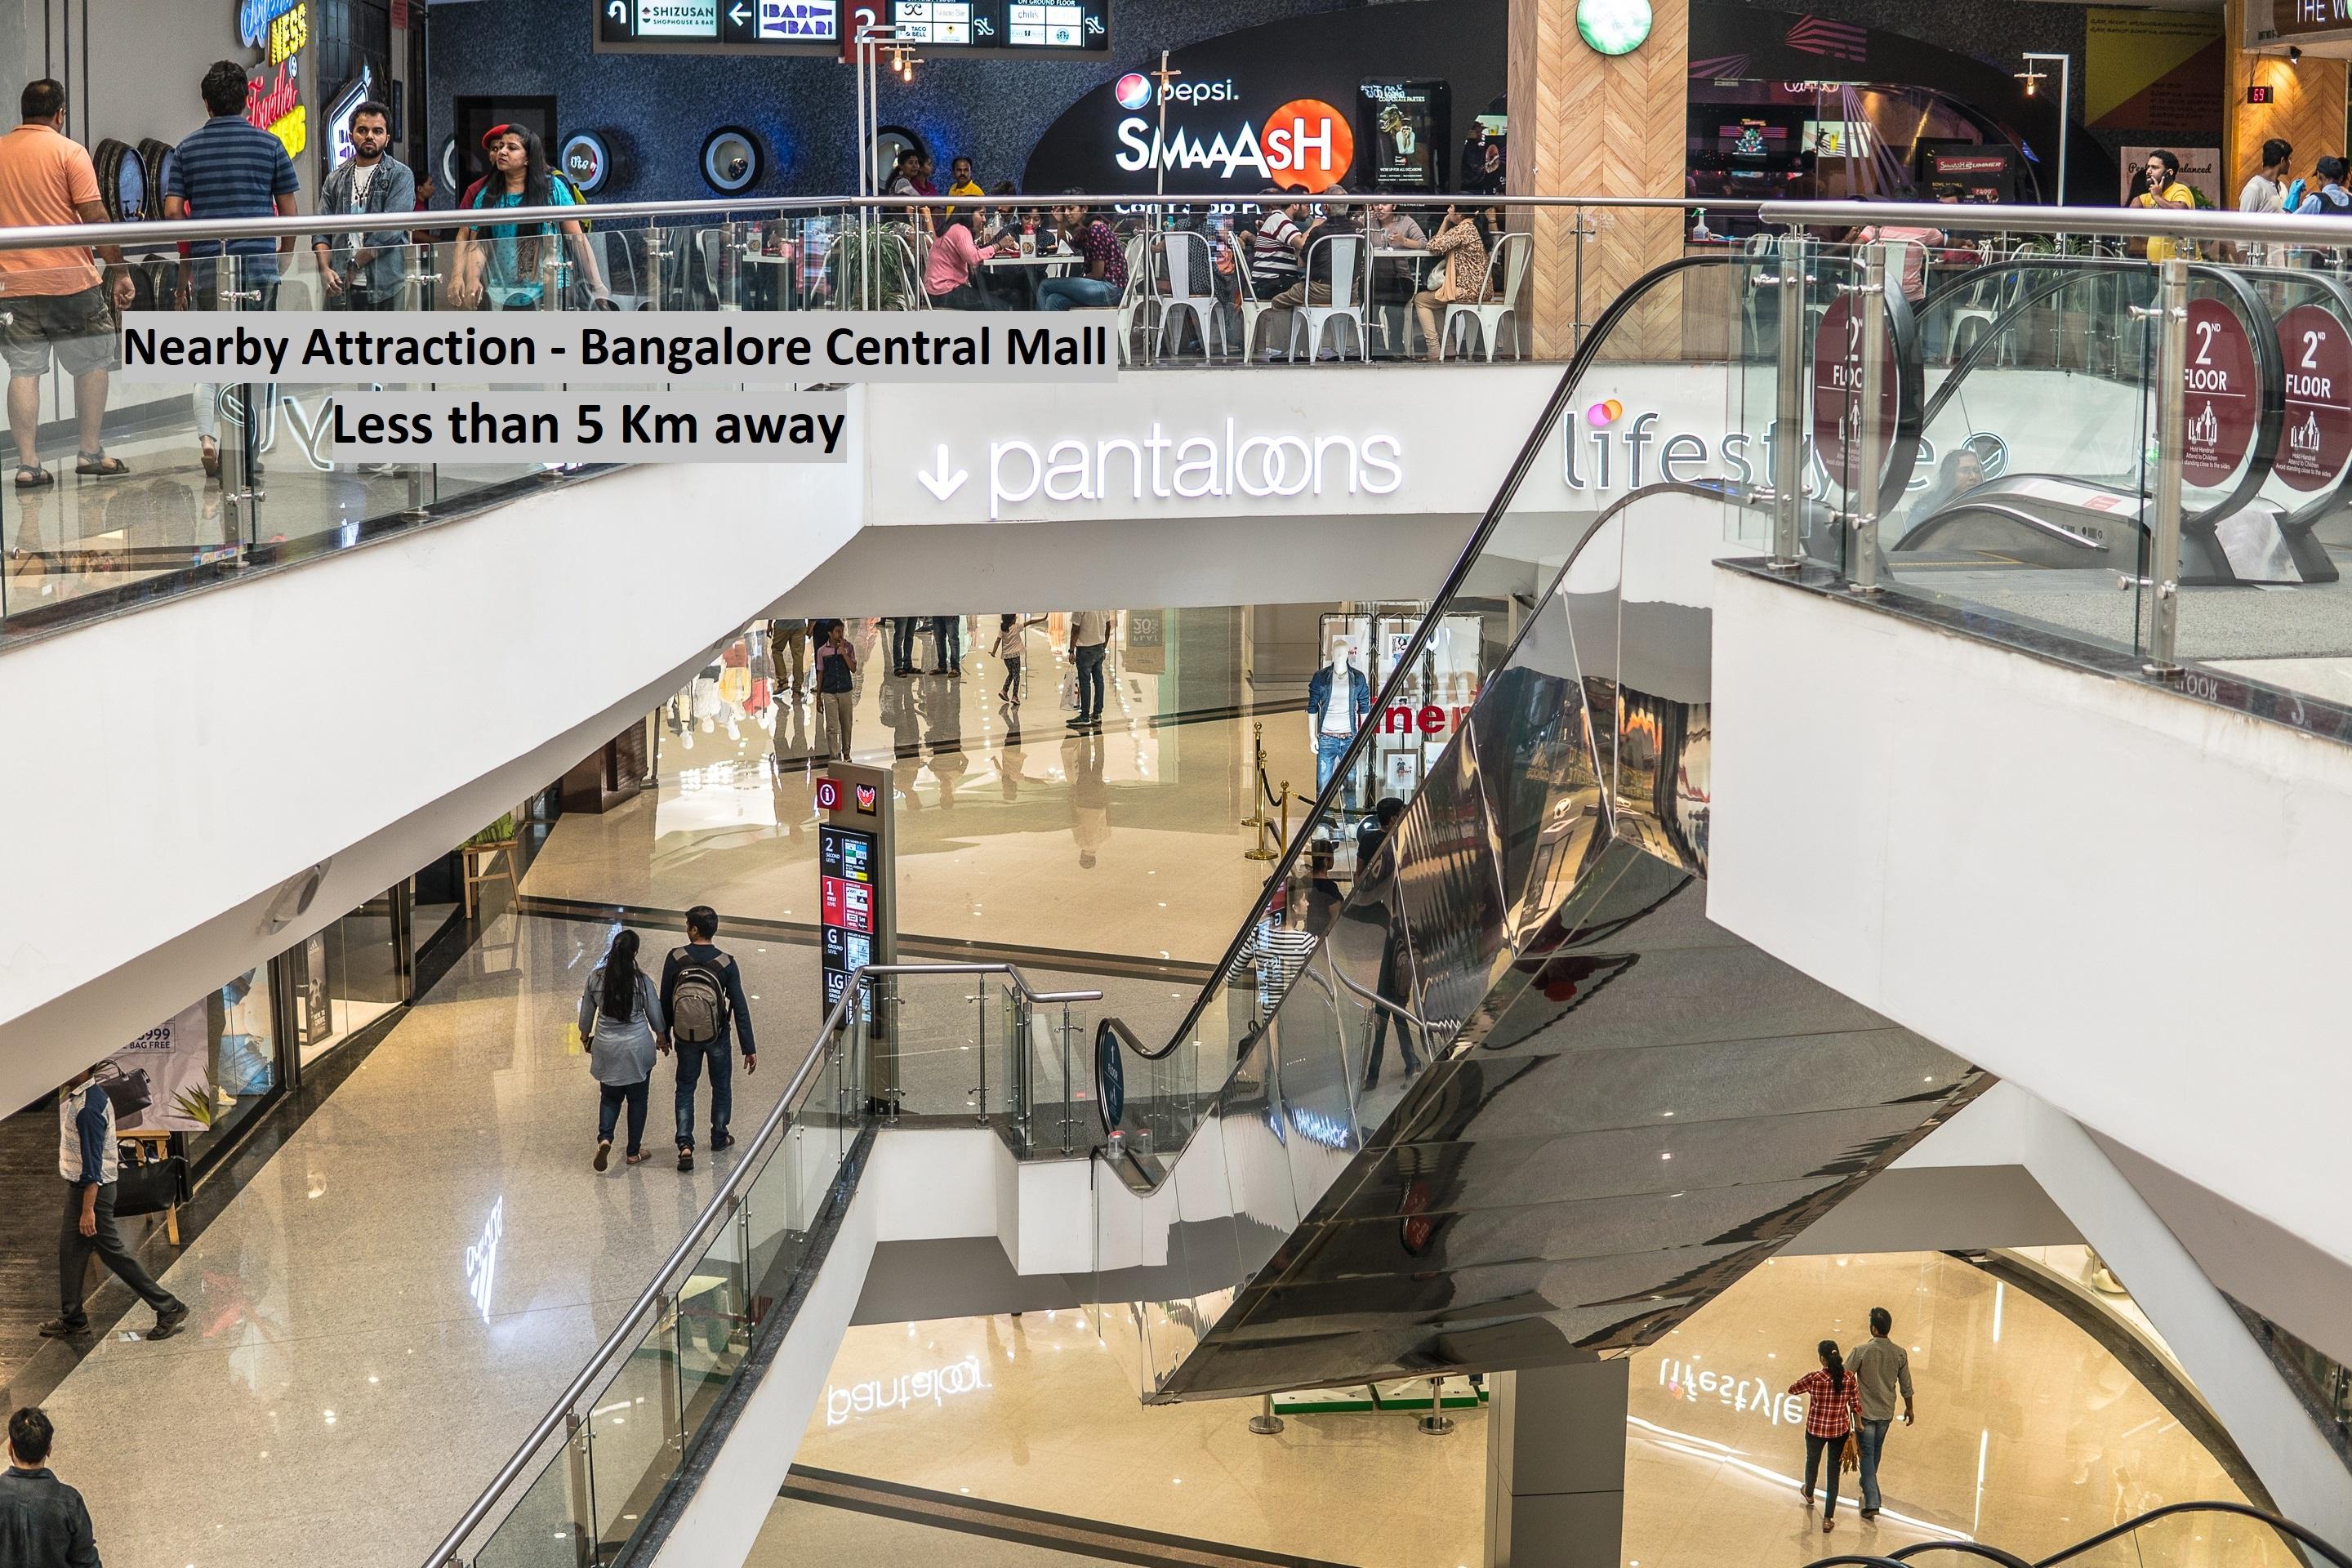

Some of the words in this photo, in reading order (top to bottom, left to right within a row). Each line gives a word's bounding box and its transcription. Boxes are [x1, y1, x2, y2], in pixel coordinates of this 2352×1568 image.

[653, 7, 714, 17] SHIZUSAN
[854, 8, 876, 43] 2
[2254, 88, 2265, 101] 69
[2178, 163, 2212, 174] alanced
[1833, 365, 1863, 388] FLOO
[2286, 373, 2331, 399] FLOOR
[990, 417, 1403, 519] pantaloons
[2184, 461, 2199, 469] standing
[2275, 462, 2286, 470] Avoid
[2286, 465, 2301, 474] standing
[2321, 470, 2331, 478] sides
[2305, 460, 2319, 469] Children
[826, 837, 833, 852] 2
[826, 881, 834, 896] 1
[828, 929, 837, 944] G
[828, 973, 844, 990] LG
[129, 1041, 148, 1049] BAG
[149, 1041, 171, 1049] FREE
